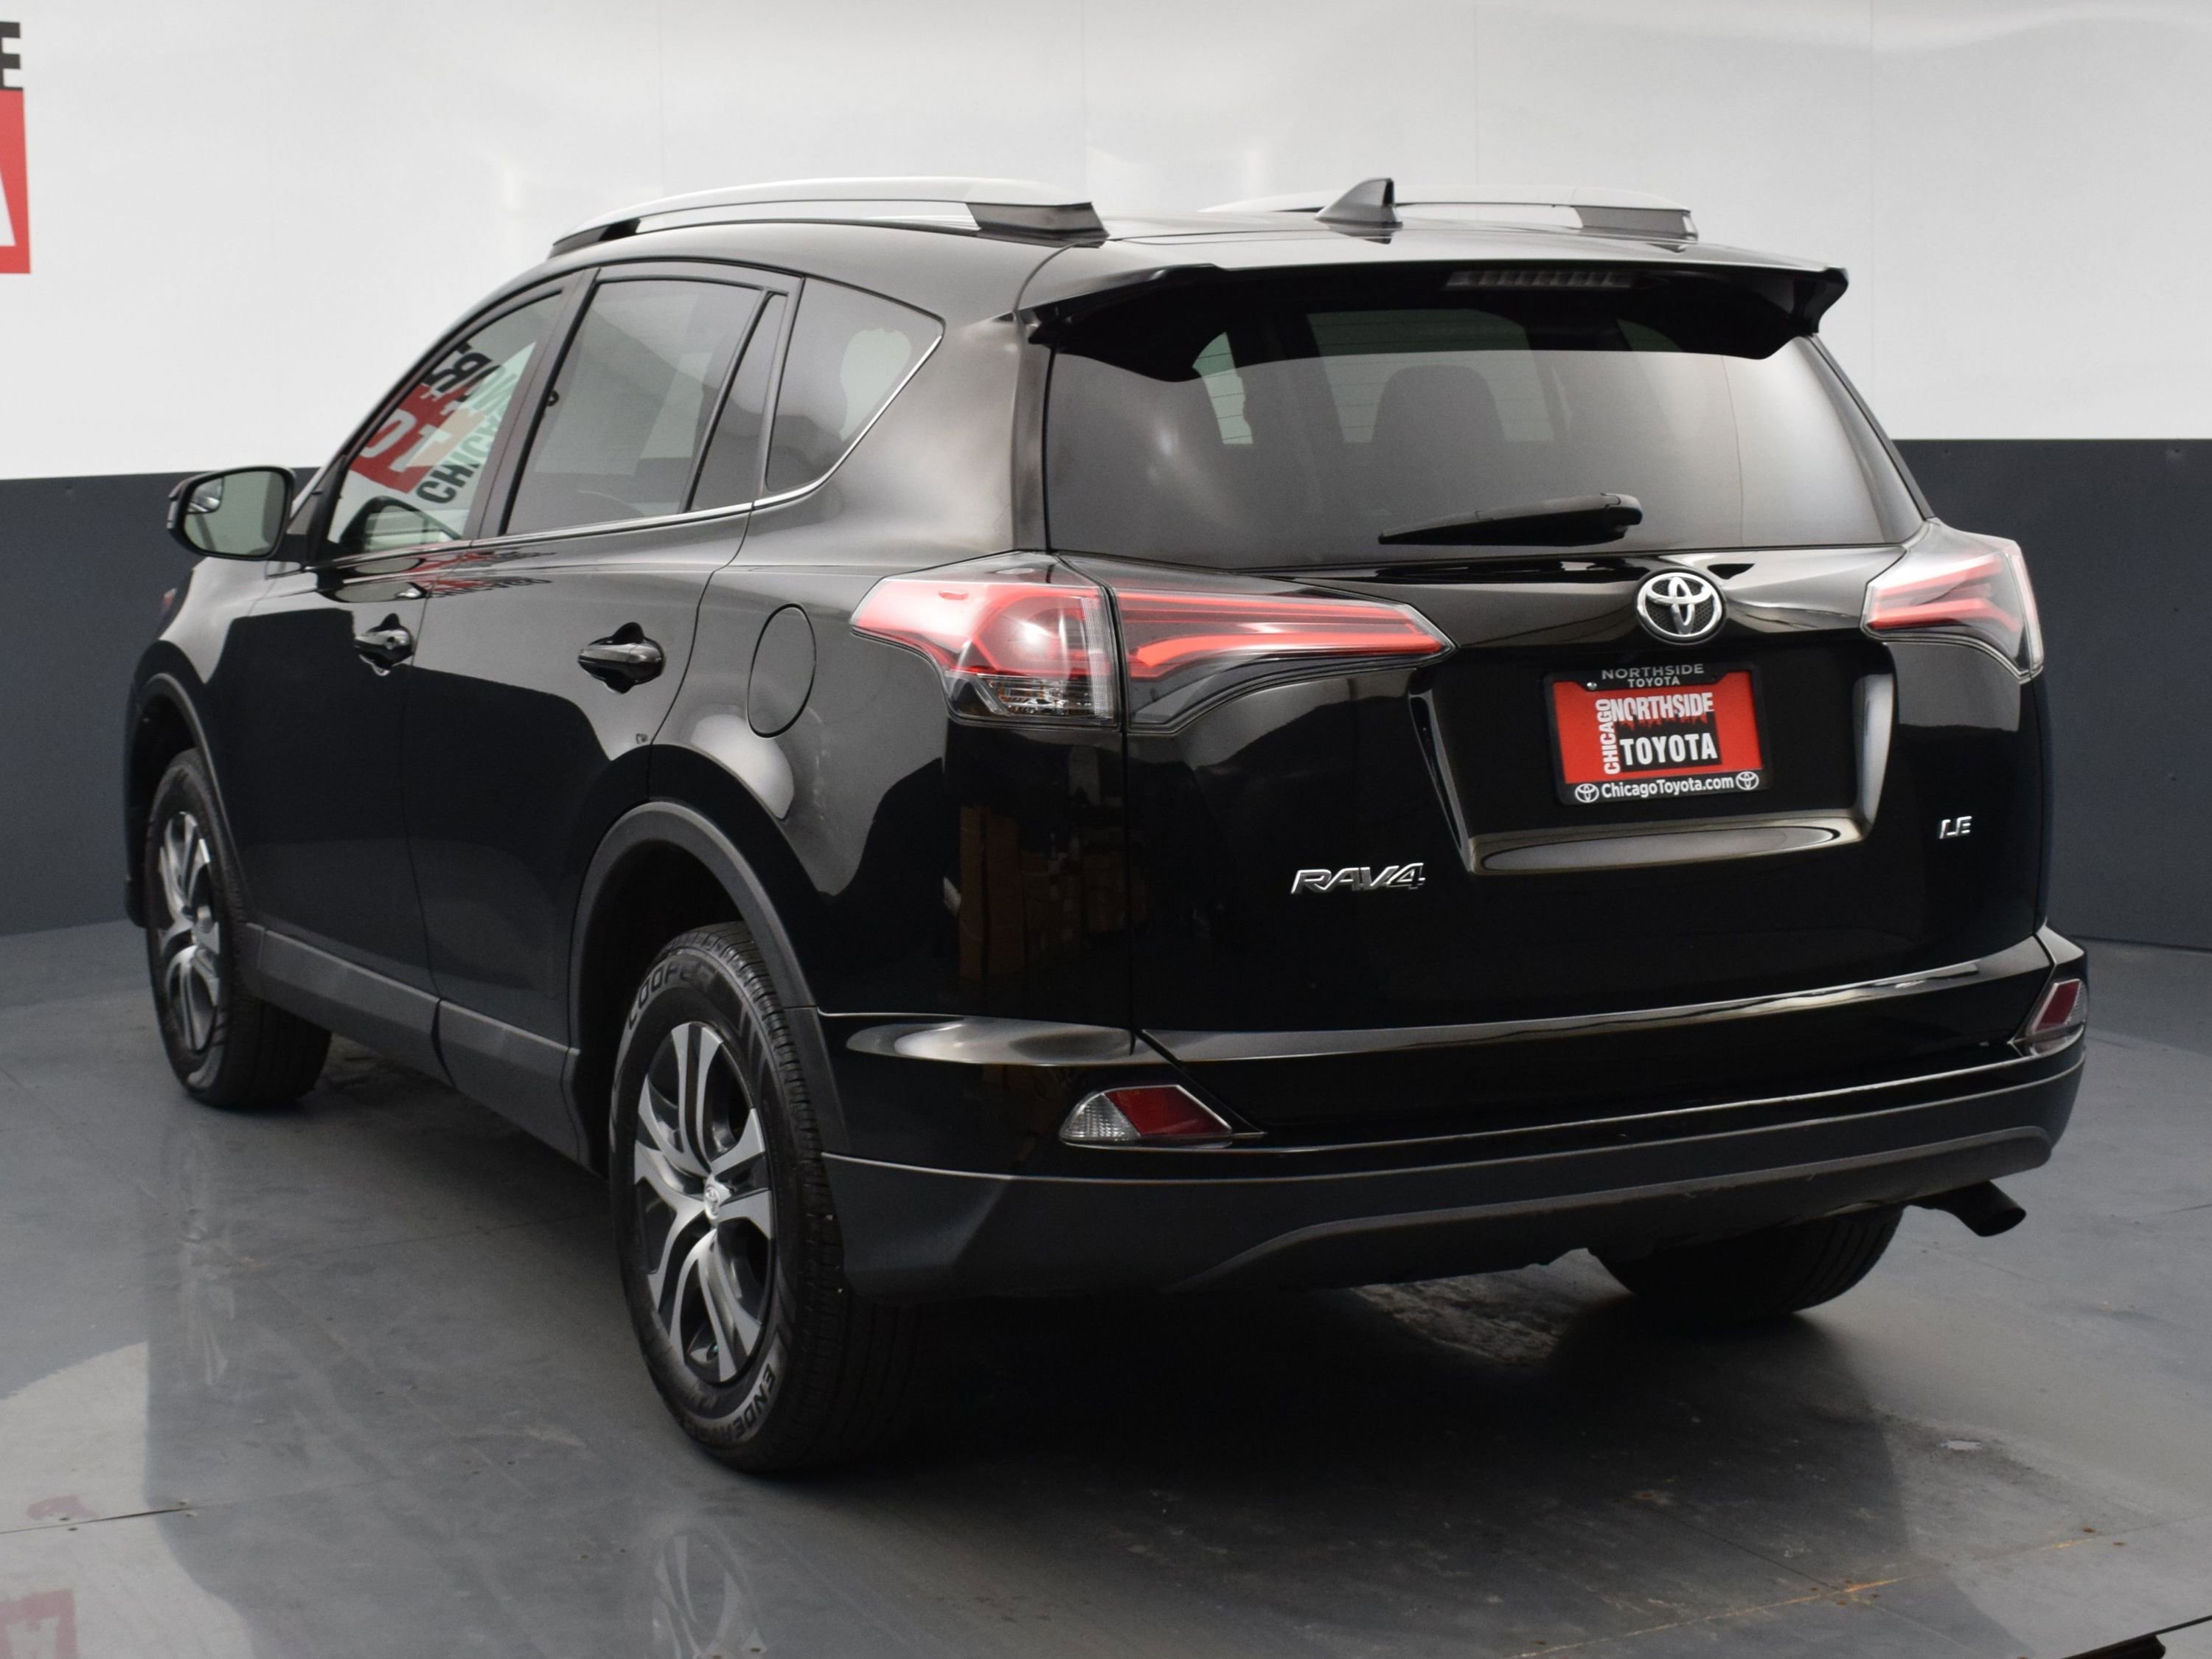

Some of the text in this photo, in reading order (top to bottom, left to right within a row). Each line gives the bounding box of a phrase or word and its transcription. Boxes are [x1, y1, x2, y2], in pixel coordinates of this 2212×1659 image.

[1601, 664, 1704, 680] NORTHSIDE
[1627, 676, 1681, 689] TOYOTA
[1610, 692, 1714, 723] NORTHSIDE
[1595, 698, 1621, 775] CHICAGO
[1619, 732, 1718, 766] TOYOTA
[1601, 776, 1734, 799] ChicagoToyota.com
[1938, 815, 1972, 839] LE
[1290, 862, 1426, 894] RAV4
